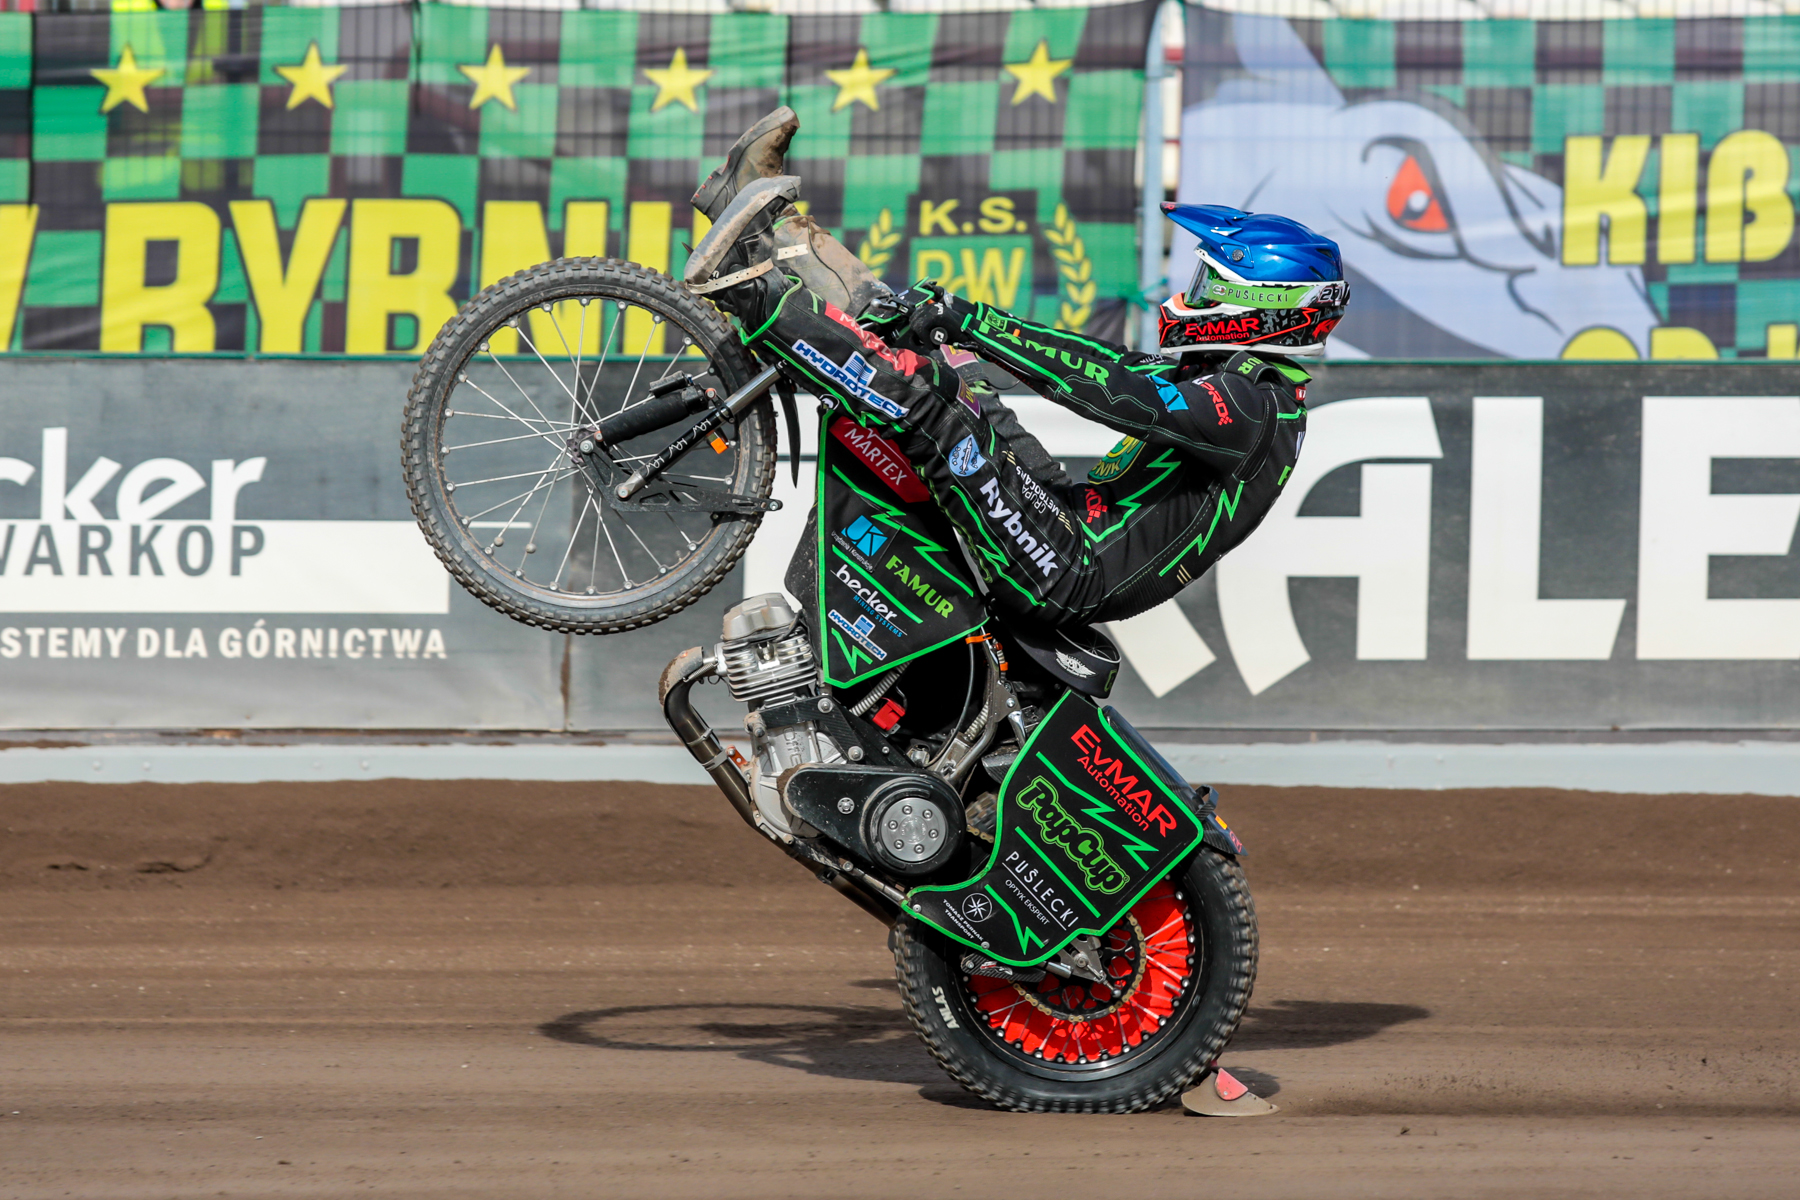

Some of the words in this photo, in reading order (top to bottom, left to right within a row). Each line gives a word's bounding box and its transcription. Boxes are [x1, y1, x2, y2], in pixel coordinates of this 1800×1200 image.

[919, 196, 1029, 236] K.S.
[1185, 317, 1260, 337] EvMAR
[1195, 331, 1250, 343] Automation
[844, 428, 907, 486] MARTEX
[1023, 484, 1047, 514] GRUPA
[979, 477, 1059, 577] Rybnik
[836, 564, 898, 620] becker
[885, 555, 954, 618] FAMUR
[137, 627, 208, 659] DLA
[218, 618, 447, 660] GÓRNICTWA
[829, 611, 886, 659] HYDROTECH
[853, 594, 875, 616] MINING
[874, 613, 904, 638] SYSTEMS
[1071, 724, 1178, 838] EvMAR
[1076, 755, 1151, 832] Automation
[1016, 775, 1129, 895] PapCup
[943, 899, 964, 921] TOMASZ
[944, 909, 975, 940] TRANSPORT
[1005, 879, 1025, 902] OPTYK
[1024, 899, 1051, 925] EKSPERT
